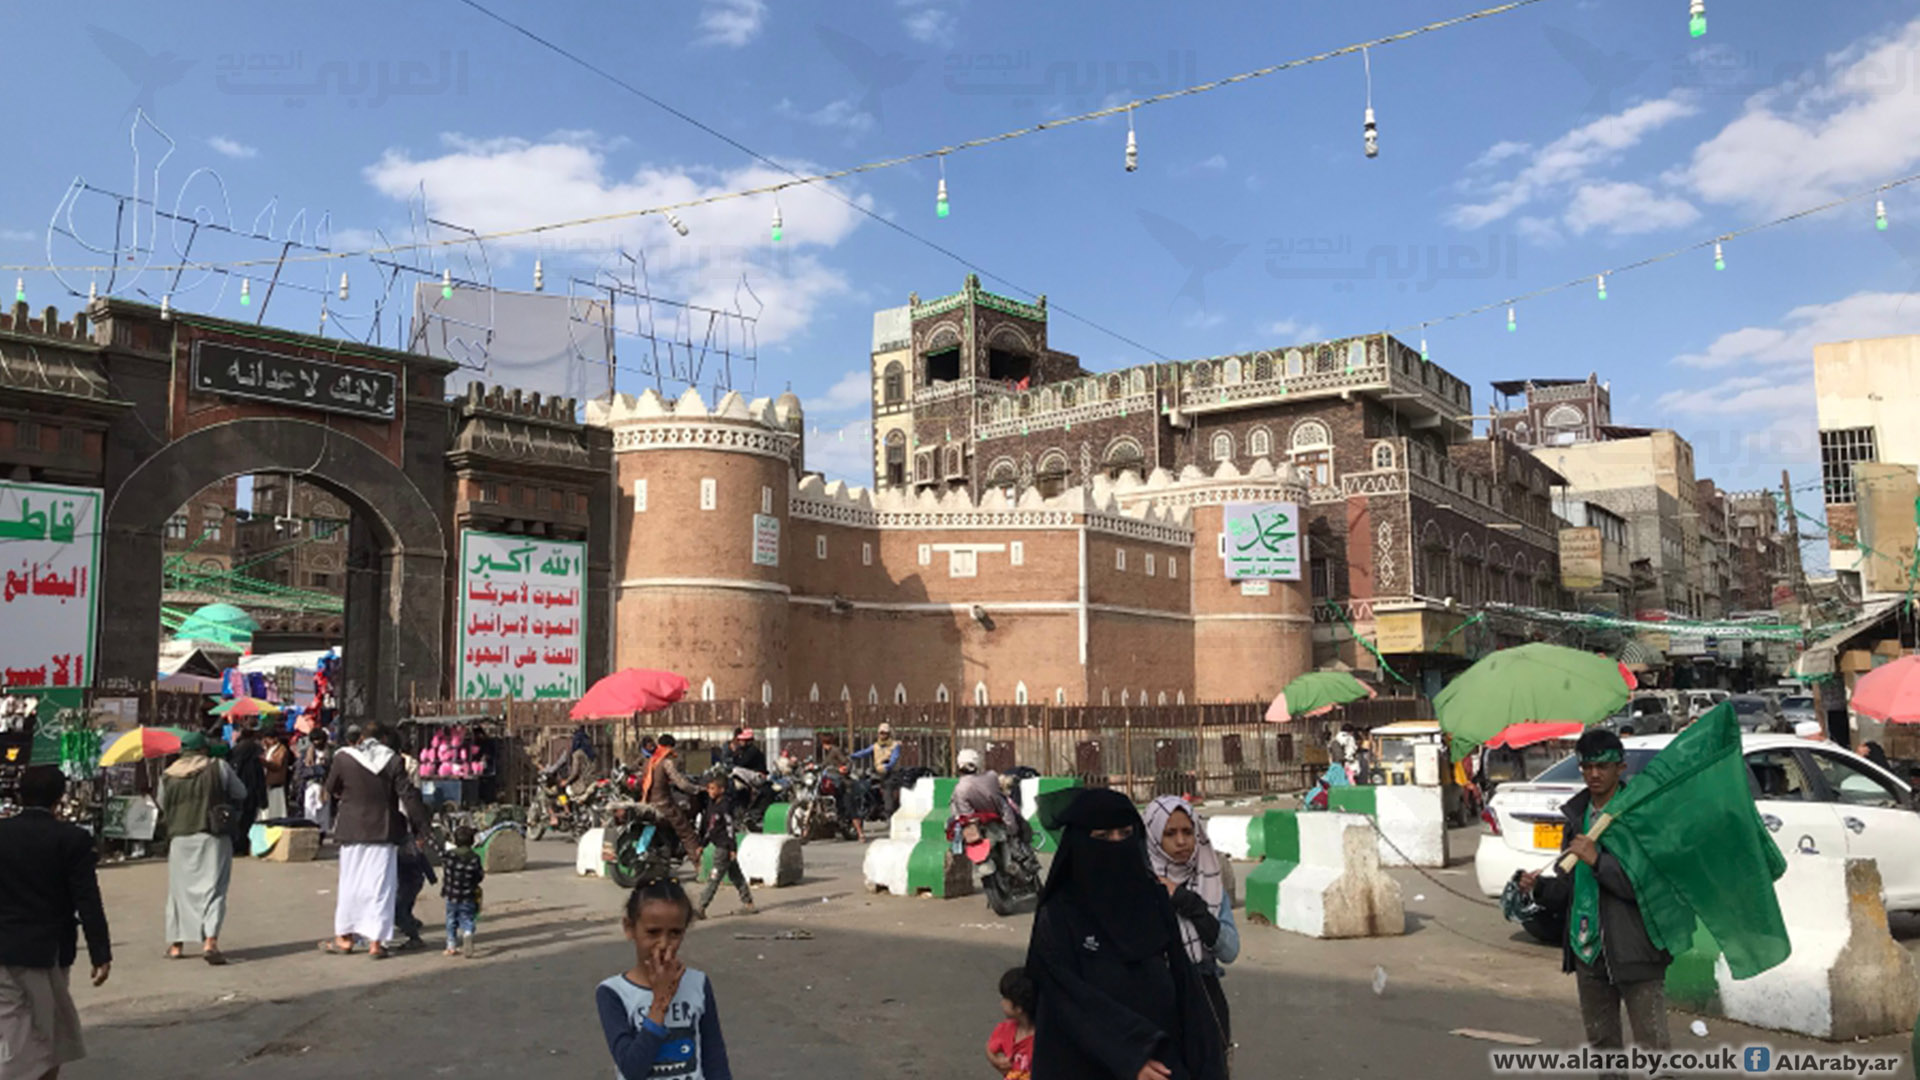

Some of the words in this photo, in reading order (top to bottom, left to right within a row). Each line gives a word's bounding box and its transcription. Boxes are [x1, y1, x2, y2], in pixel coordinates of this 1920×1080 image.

[539, 548, 580, 576] الله
[532, 588, 580, 610] الموت
[532, 617, 580, 640] الموت
[466, 645, 510, 668] اليهود
[514, 646, 537, 668] على
[543, 646, 579, 667] اللعنة
[532, 671, 579, 701] النصر
